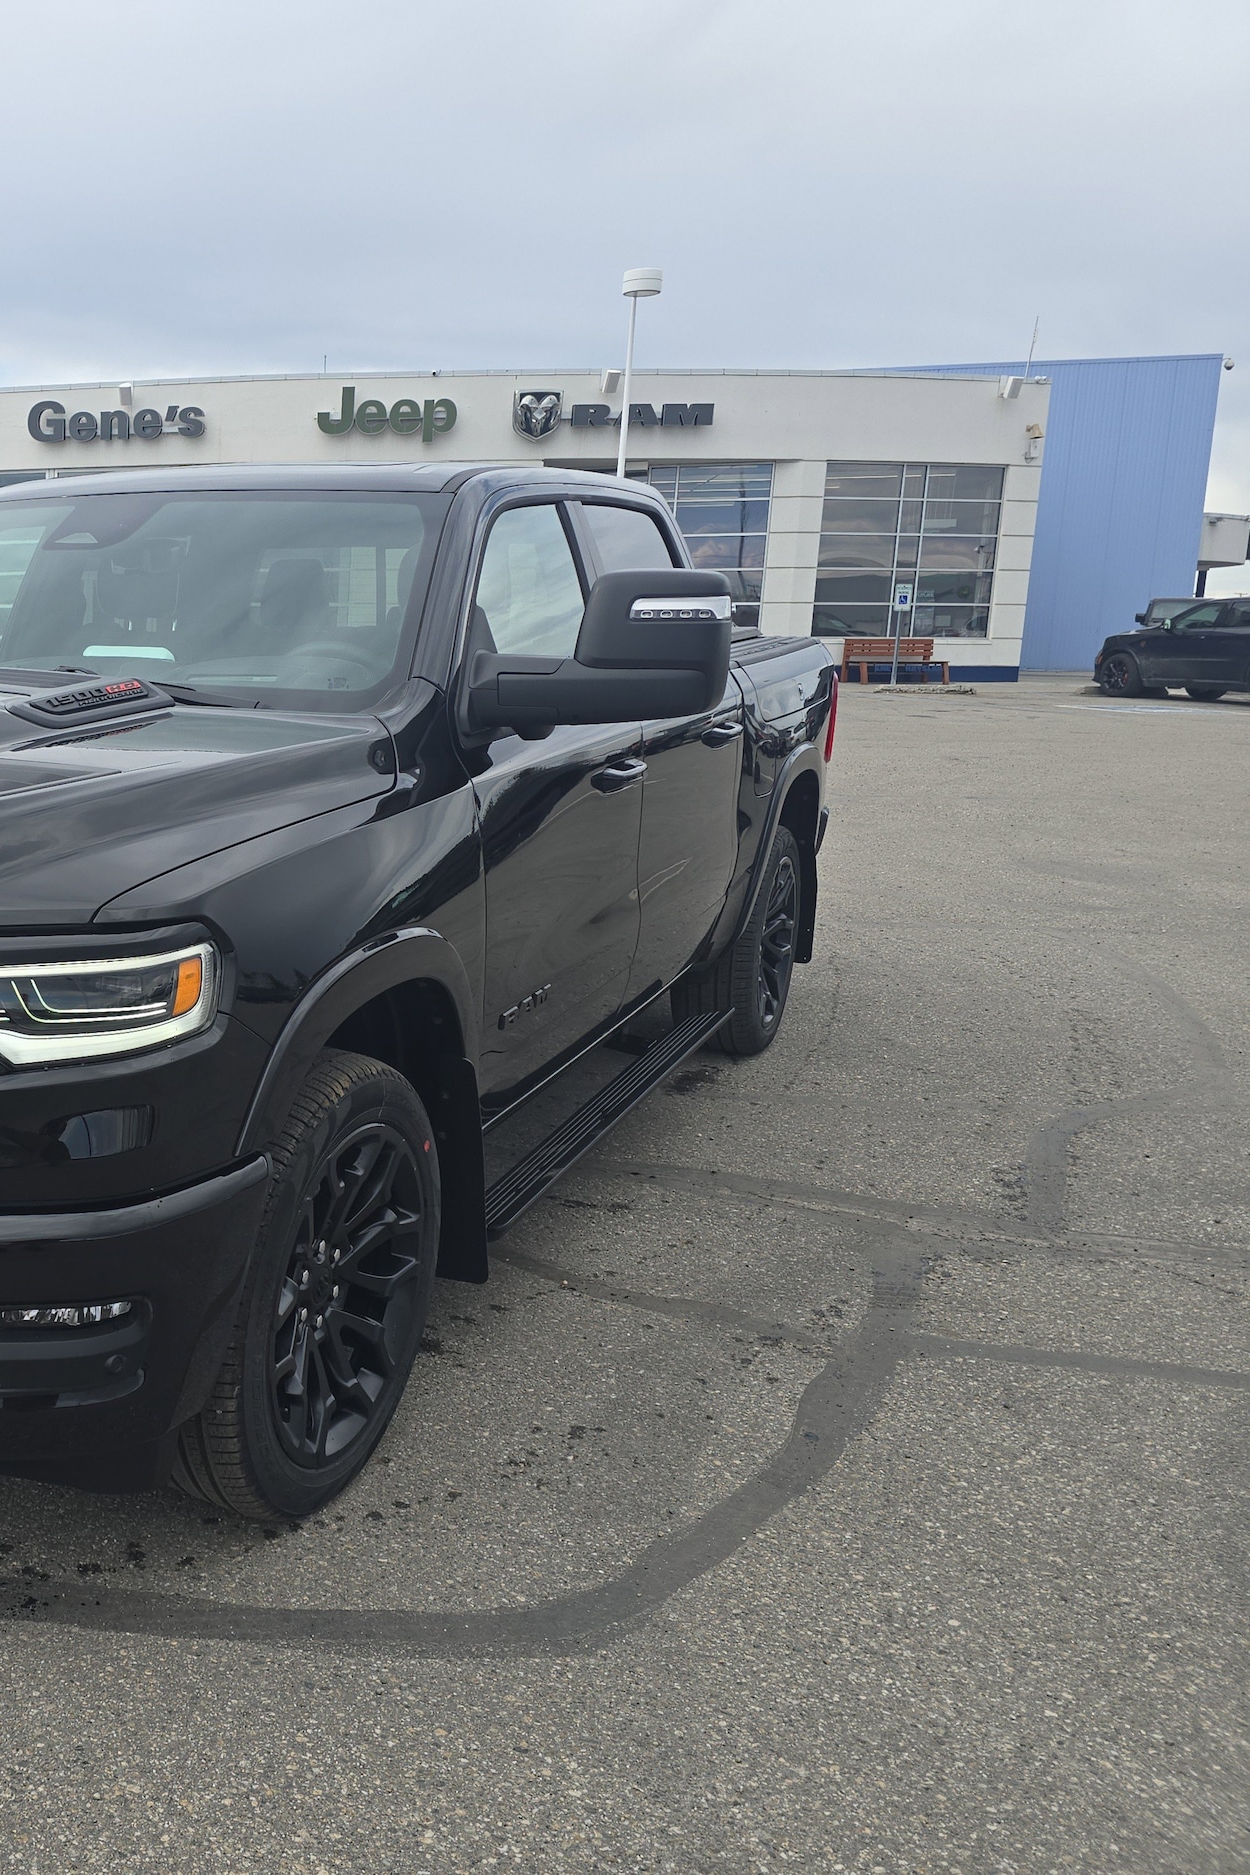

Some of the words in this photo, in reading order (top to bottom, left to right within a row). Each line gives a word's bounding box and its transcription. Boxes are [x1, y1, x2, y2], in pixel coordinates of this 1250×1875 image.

[27, 400, 206, 443] Gene's
[317, 386, 457, 443] Jeep
[571, 403, 715, 427] RAM
[46, 687, 108, 707] 1500
[497, 983, 552, 1031] RAM
